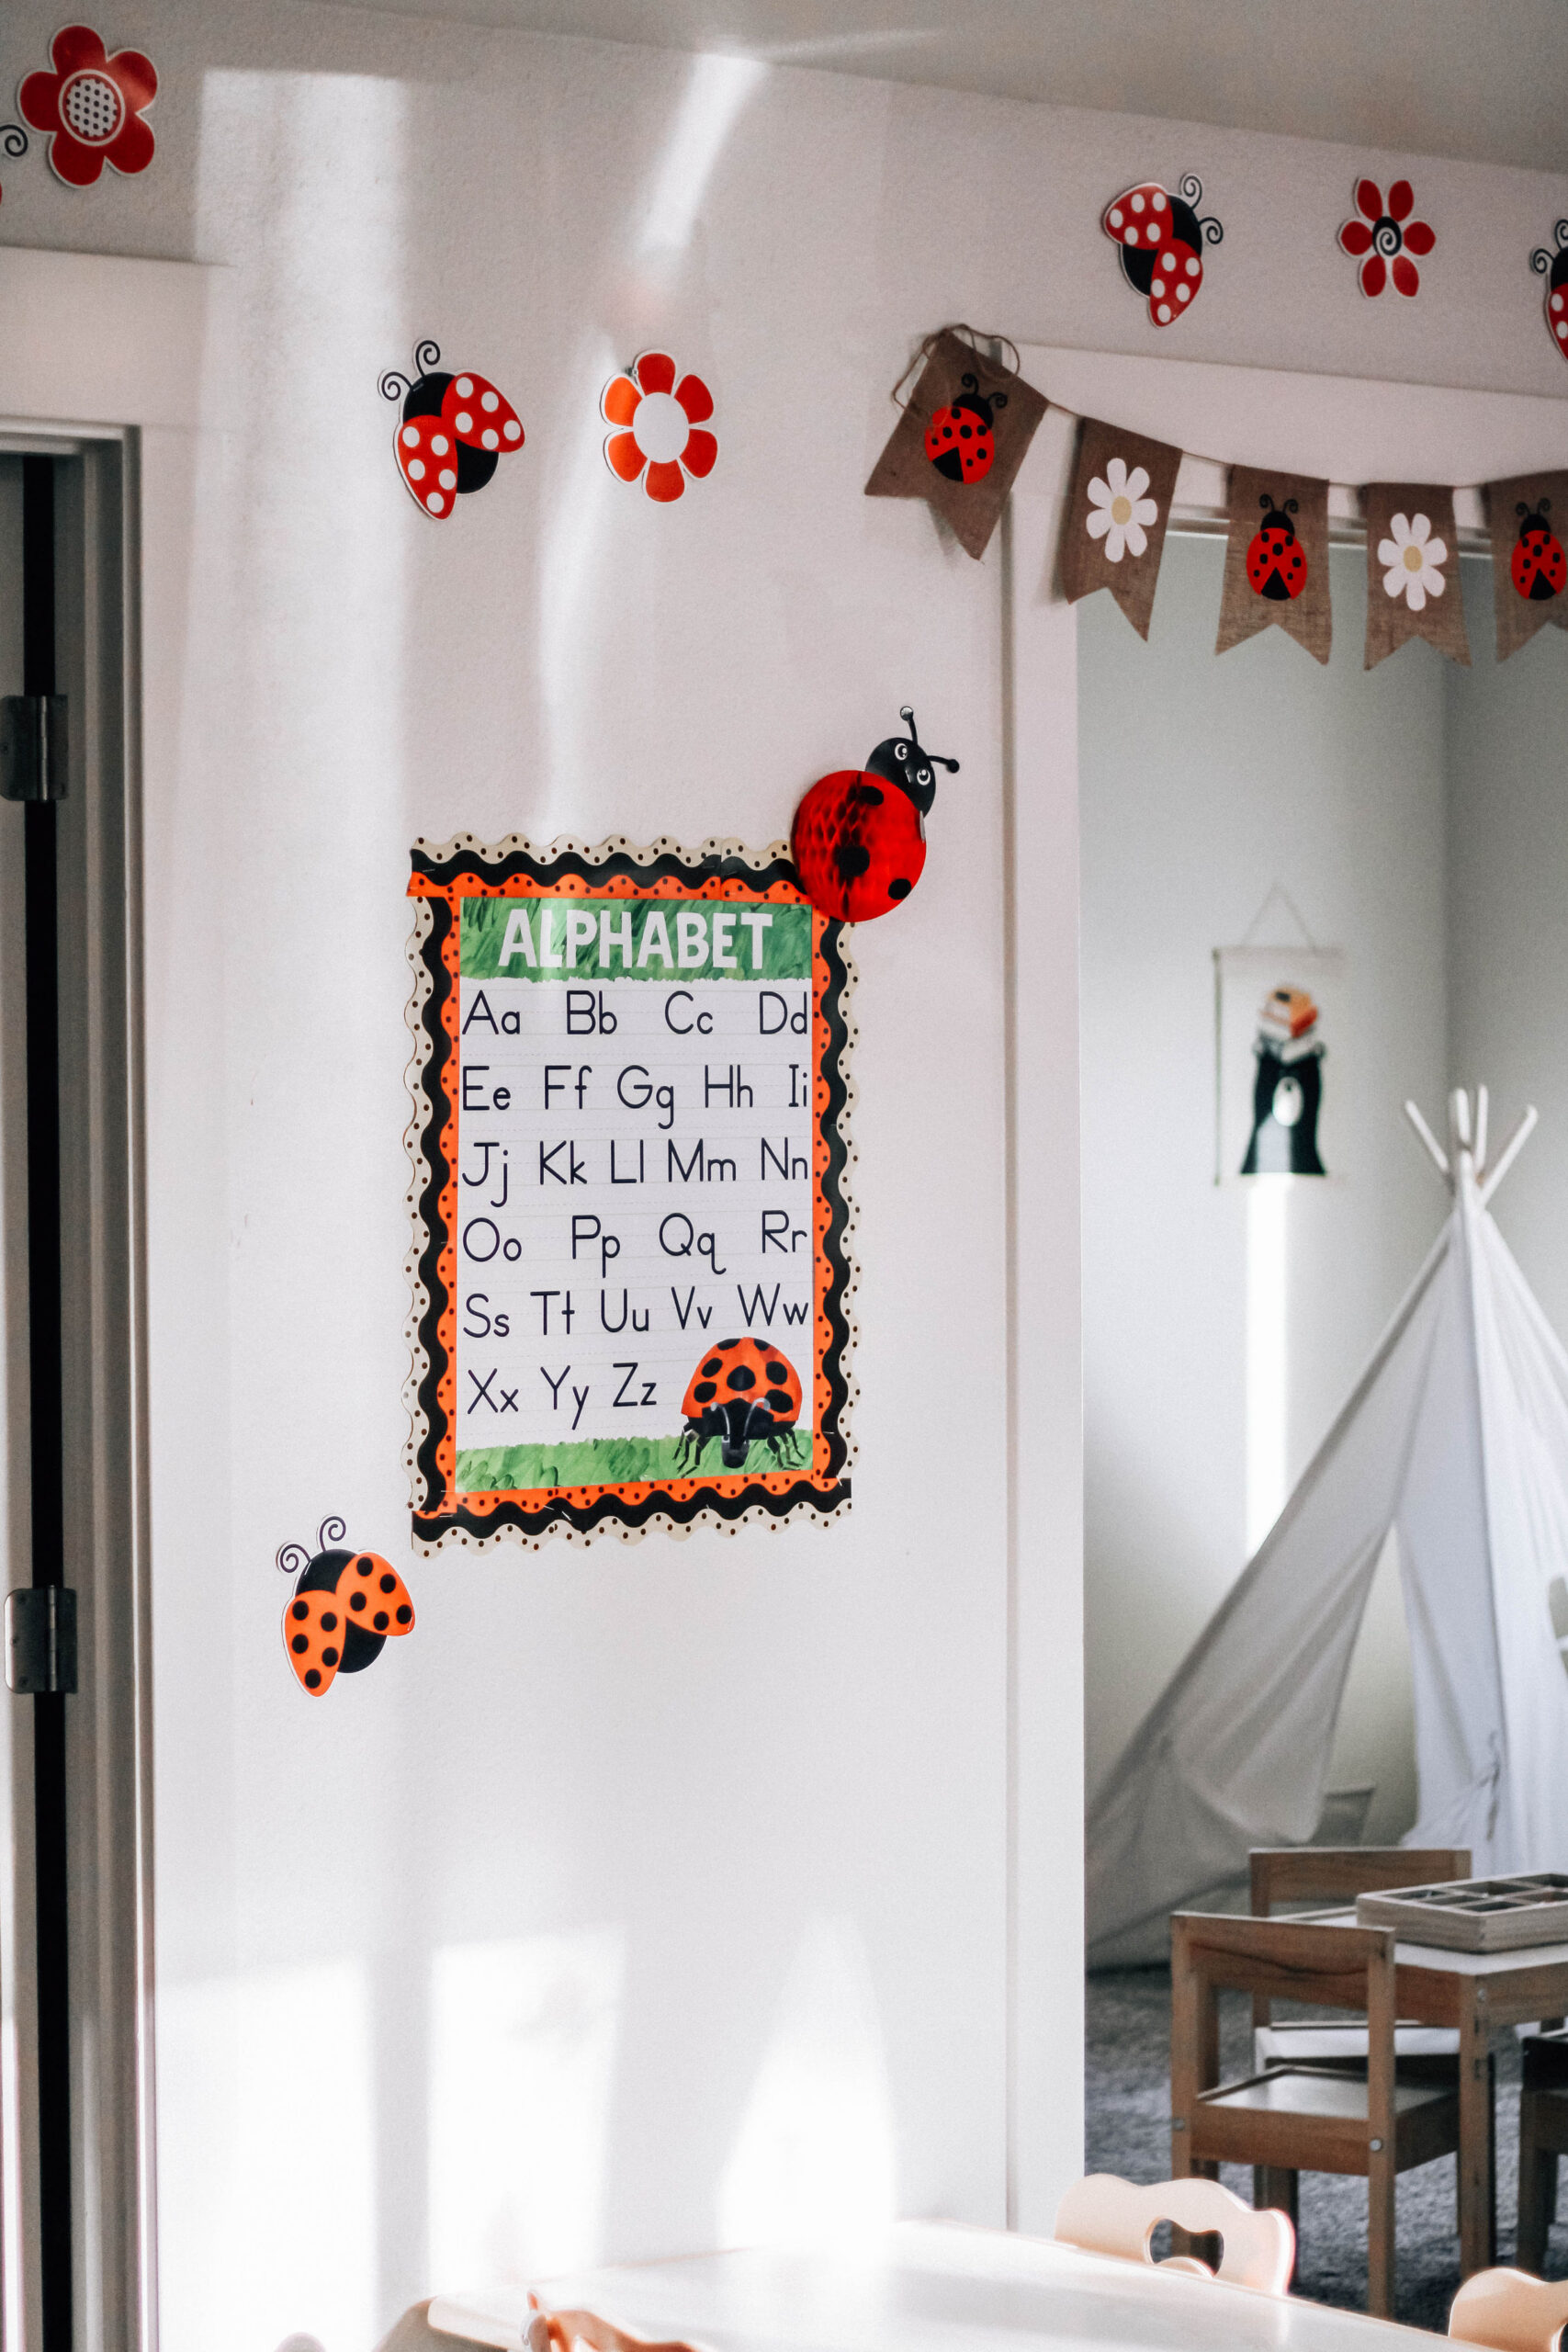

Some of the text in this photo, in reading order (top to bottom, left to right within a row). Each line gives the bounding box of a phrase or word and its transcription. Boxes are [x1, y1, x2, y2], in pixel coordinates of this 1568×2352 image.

[499, 910, 773, 970] ALPHABET
[463, 989, 808, 1035] Aa Bb Cc Dd
[462, 1063, 808, 1130] Ee Ff Gg Hh Ii
[461, 1136, 808, 1208] Jj Kk Ll Mm Nn
[462, 1209, 808, 1279] Oo Pp Qq Rr
[463, 1283, 809, 1339] Ss Tt Uu Vv Ww
[467, 1362, 658, 1430] Xx Yy Zz
